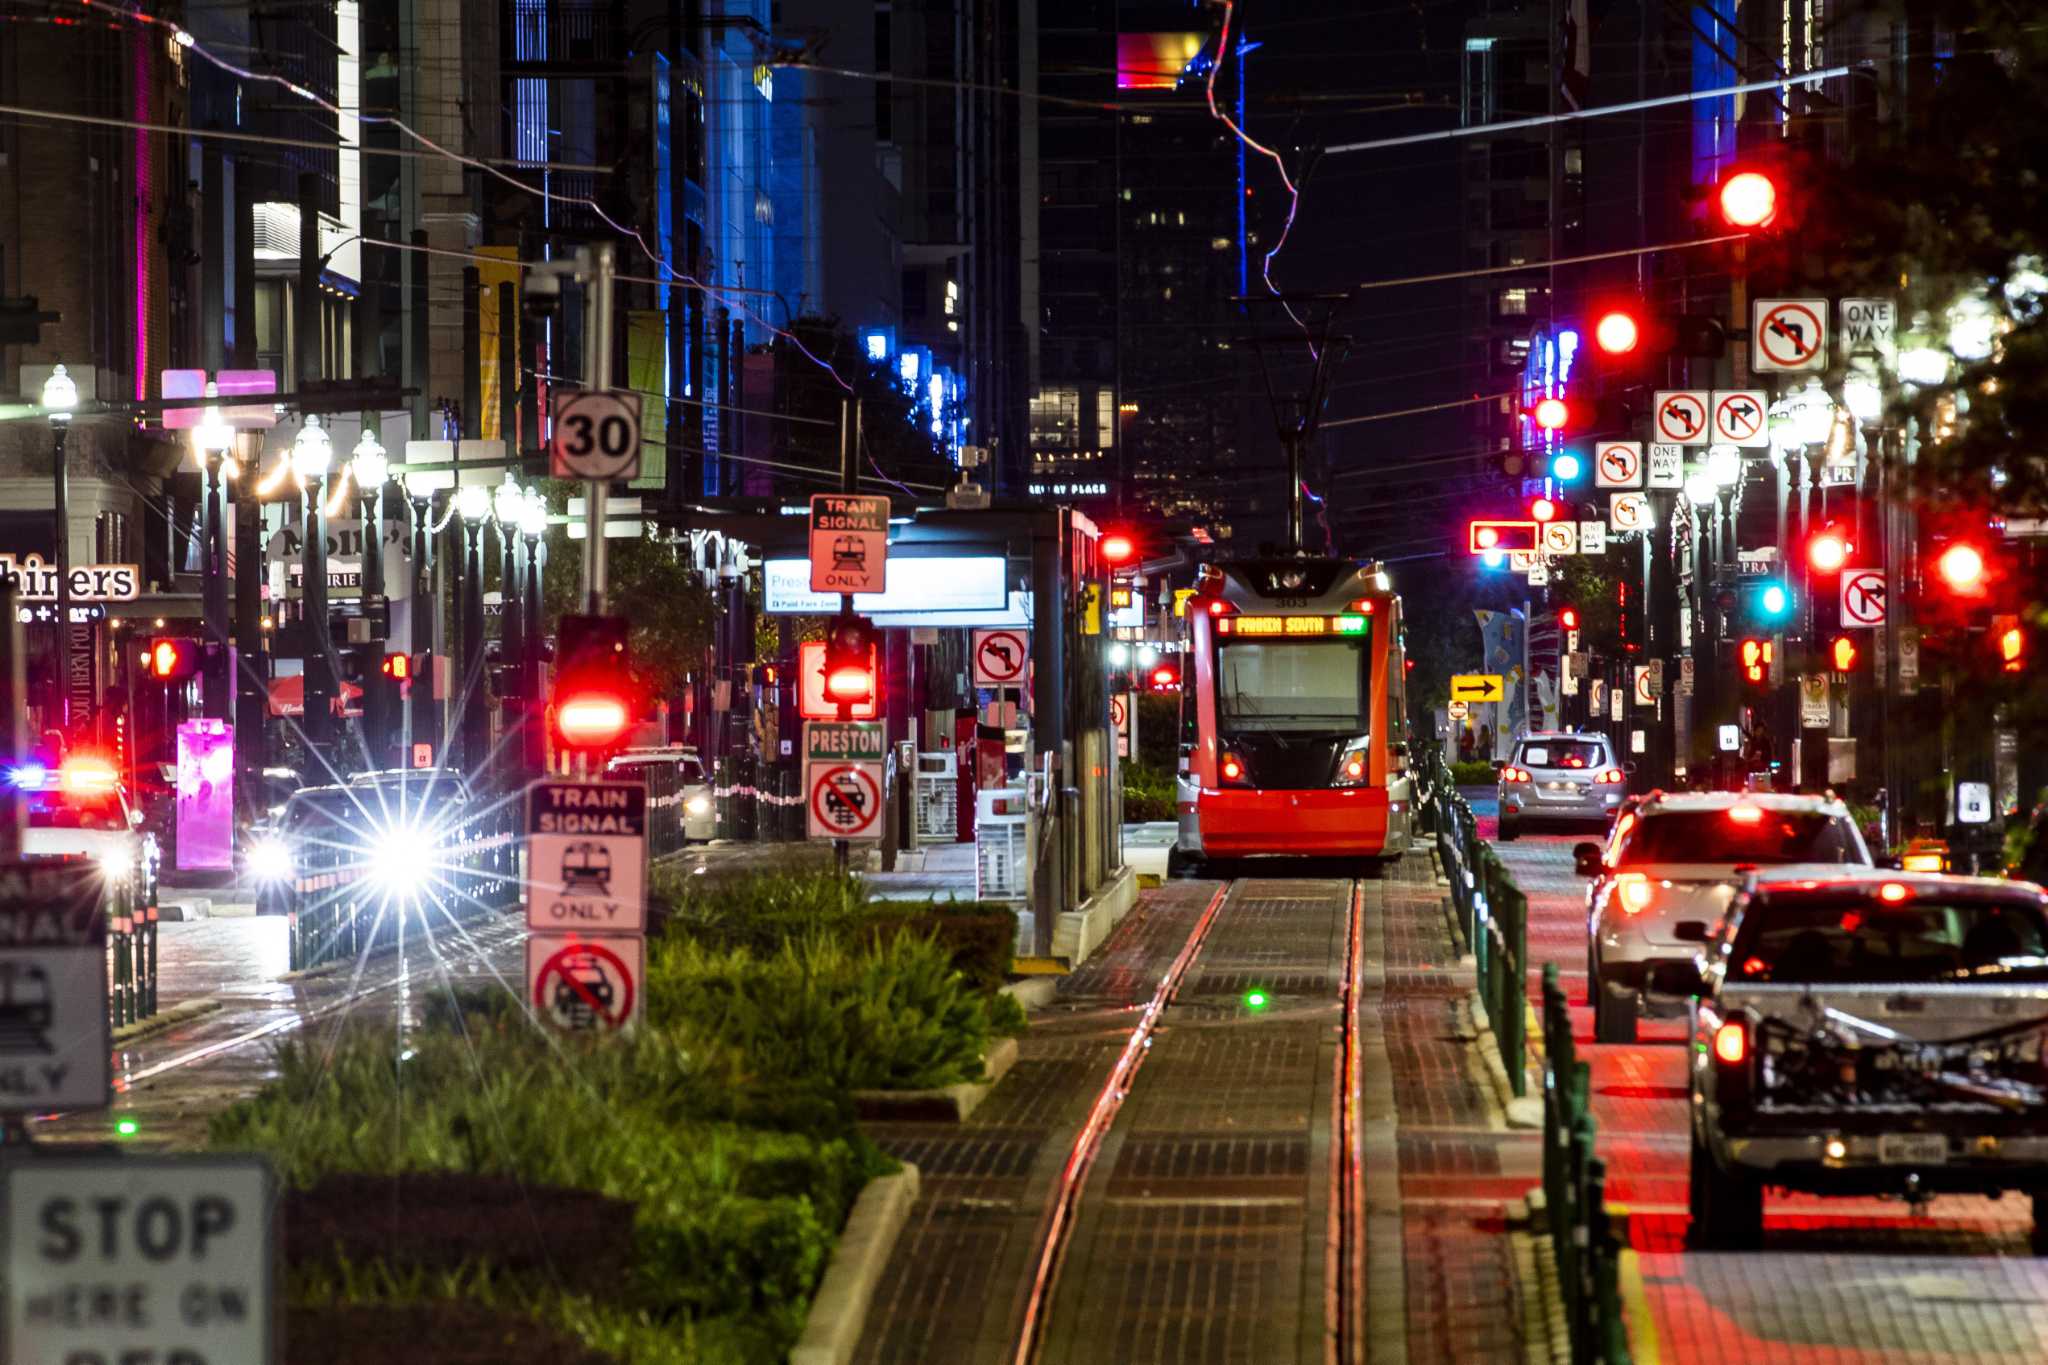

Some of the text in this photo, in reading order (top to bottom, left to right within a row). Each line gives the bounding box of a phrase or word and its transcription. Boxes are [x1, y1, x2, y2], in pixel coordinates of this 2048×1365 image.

[1848, 304, 1889, 321] ONE
[1847, 324, 1890, 342] WAY
[564, 415, 630, 456] 30
[1653, 446, 1678, 457] ONE
[1652, 458, 1678, 468] WAY
[826, 500, 876, 512] TRAIN
[819, 516, 879, 528] SIGNAL
[826, 575, 869, 586] ONLY
[810, 730, 881, 752] PRESTON
[550, 788, 627, 807] TRAIN
[541, 814, 634, 832] SIGNAL
[550, 902, 618, 919] ONLY
[38, 1194, 236, 1263] STOP
